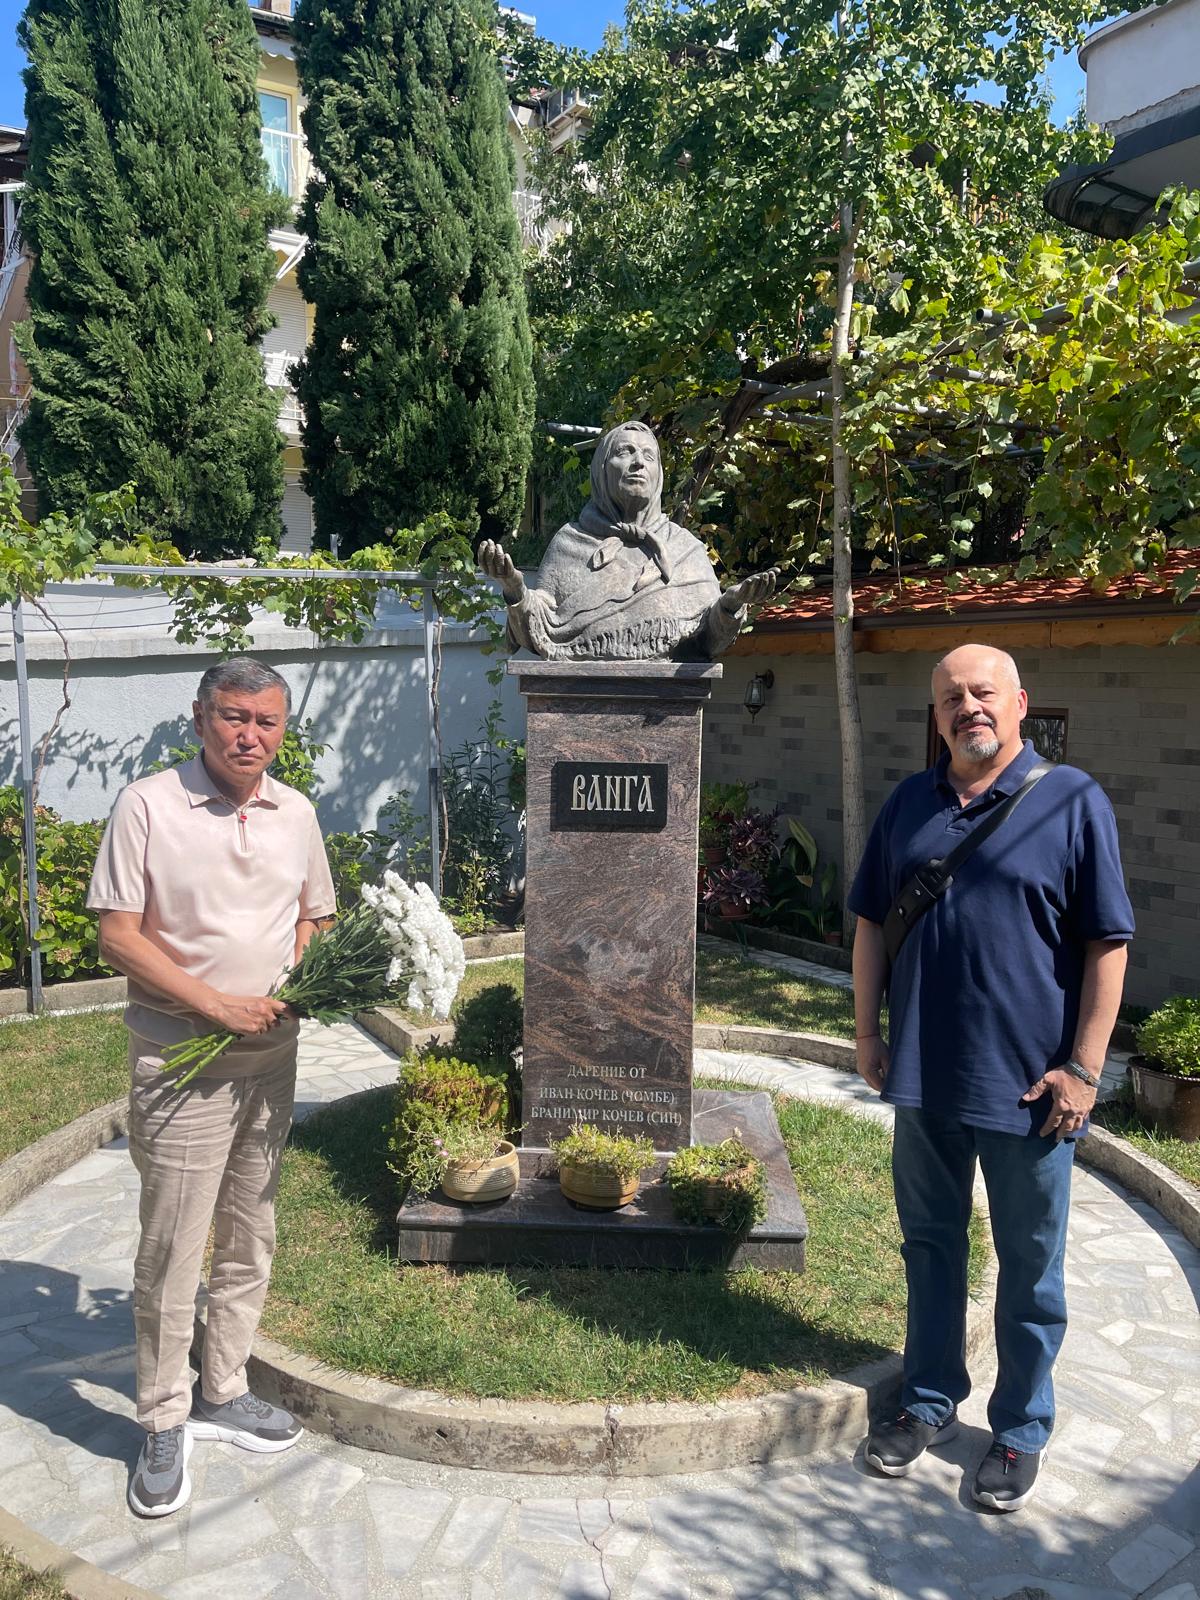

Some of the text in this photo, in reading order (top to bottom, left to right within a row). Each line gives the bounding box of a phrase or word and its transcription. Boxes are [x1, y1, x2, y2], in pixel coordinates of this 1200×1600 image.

[571, 774, 655, 812] ВАНГА
[567, 1064, 648, 1079] ДАРЕНИЕ ОТ
[539, 1087, 675, 1104] ИВАН КОЧЕВ (ЧОМБЕ)
[602, 1109, 644, 1122] КОЧЕВ
[647, 1111, 682, 1126] (СИН)
